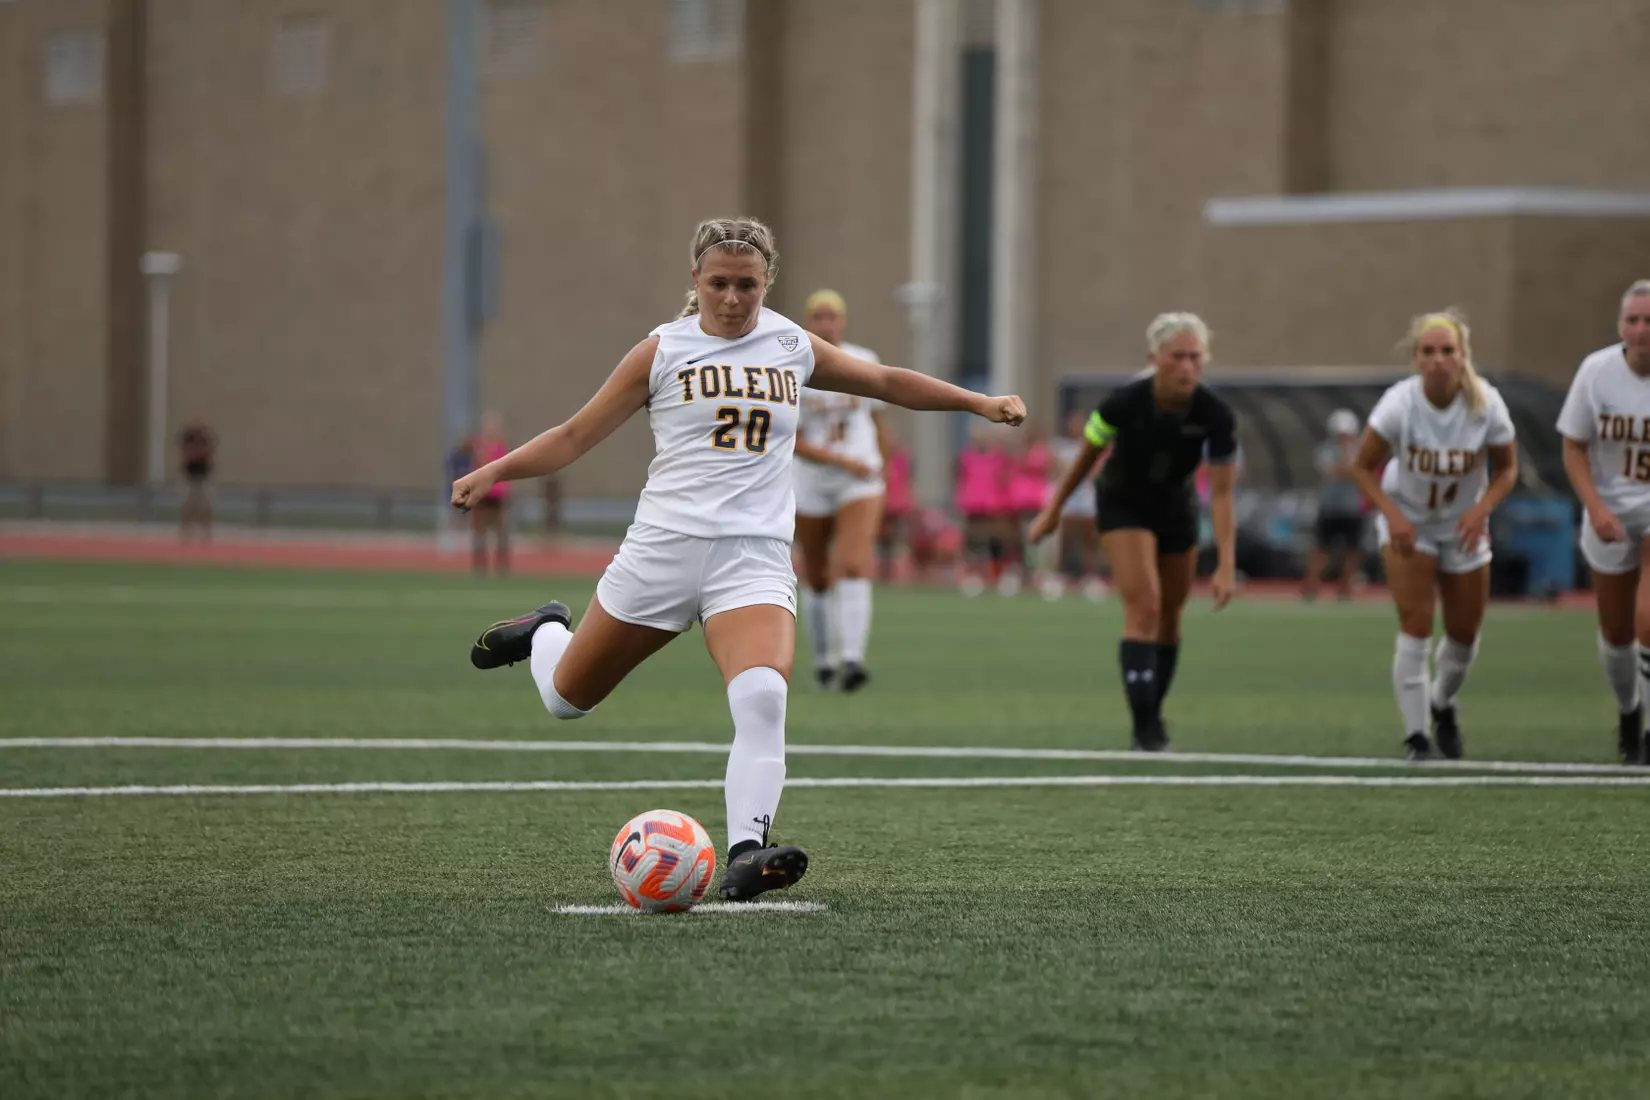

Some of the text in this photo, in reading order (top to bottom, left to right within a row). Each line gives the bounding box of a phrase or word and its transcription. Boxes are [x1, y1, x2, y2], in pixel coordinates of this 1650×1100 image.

[677, 364, 798, 407] TOLEDO
[712, 405, 773, 455] 20
[1406, 443, 1477, 477] TOLED
[1623, 446, 1650, 483] 15
[1427, 480, 1459, 510] 14
